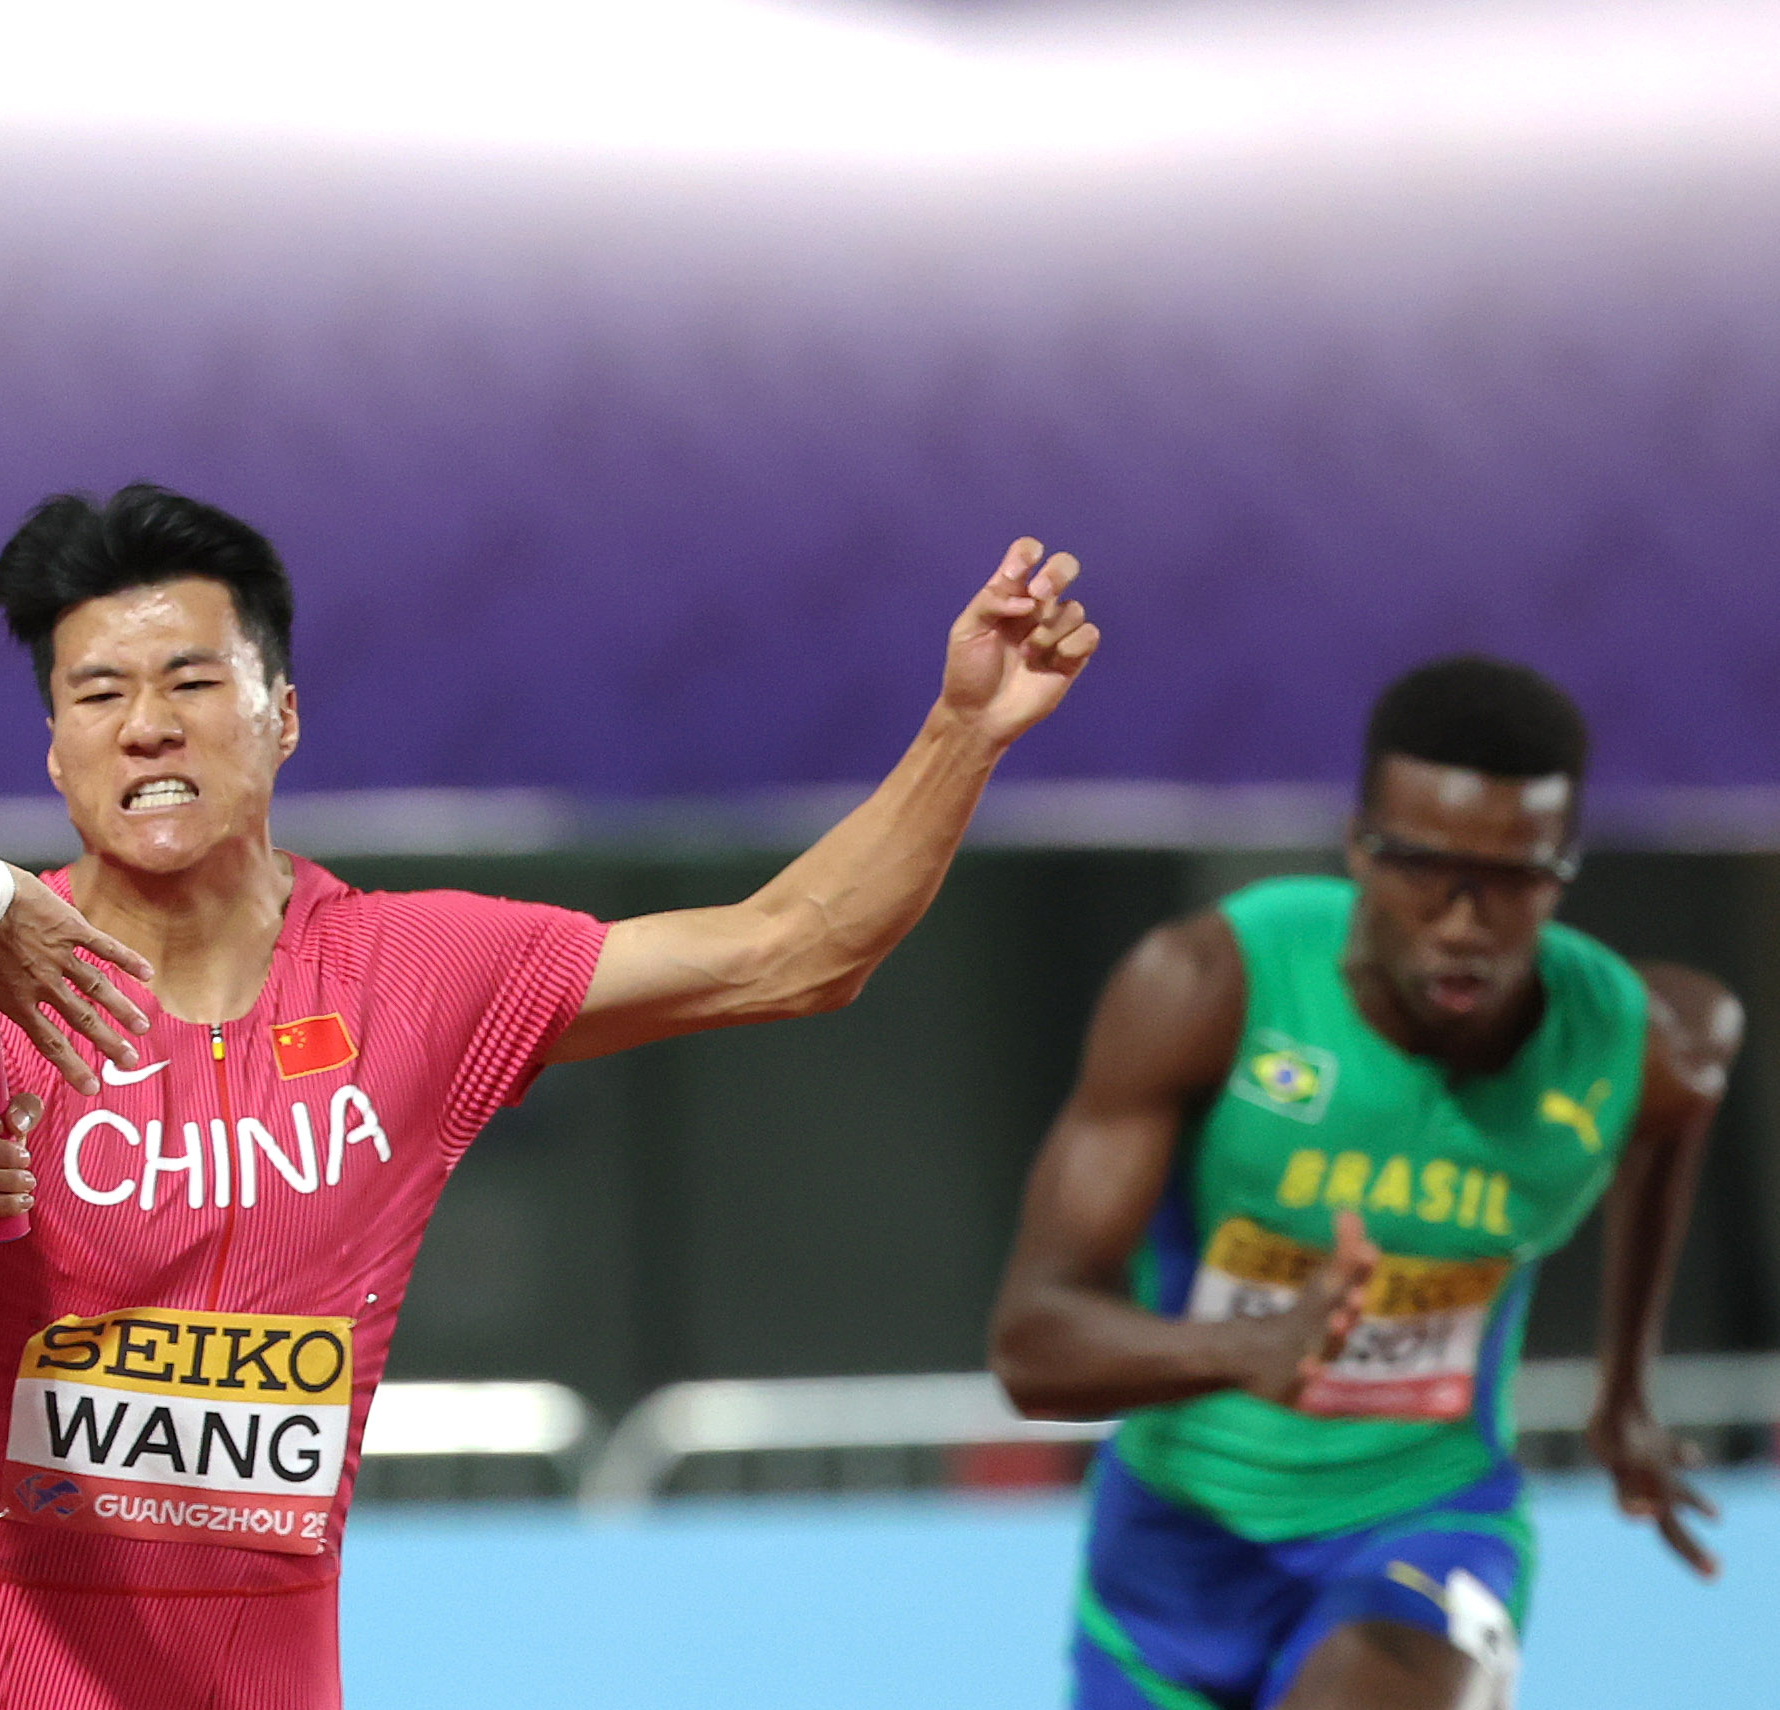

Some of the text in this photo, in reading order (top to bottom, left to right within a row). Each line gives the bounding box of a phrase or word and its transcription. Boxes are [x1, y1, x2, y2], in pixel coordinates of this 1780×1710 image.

[63, 1084, 393, 1211] CHINA
[1275, 1148, 1513, 1236] BRASIL
[36, 1319, 346, 1394] SEIKO
[43, 1389, 322, 1484] WANG
[93, 1493, 294, 1536] GUANGZHOU
